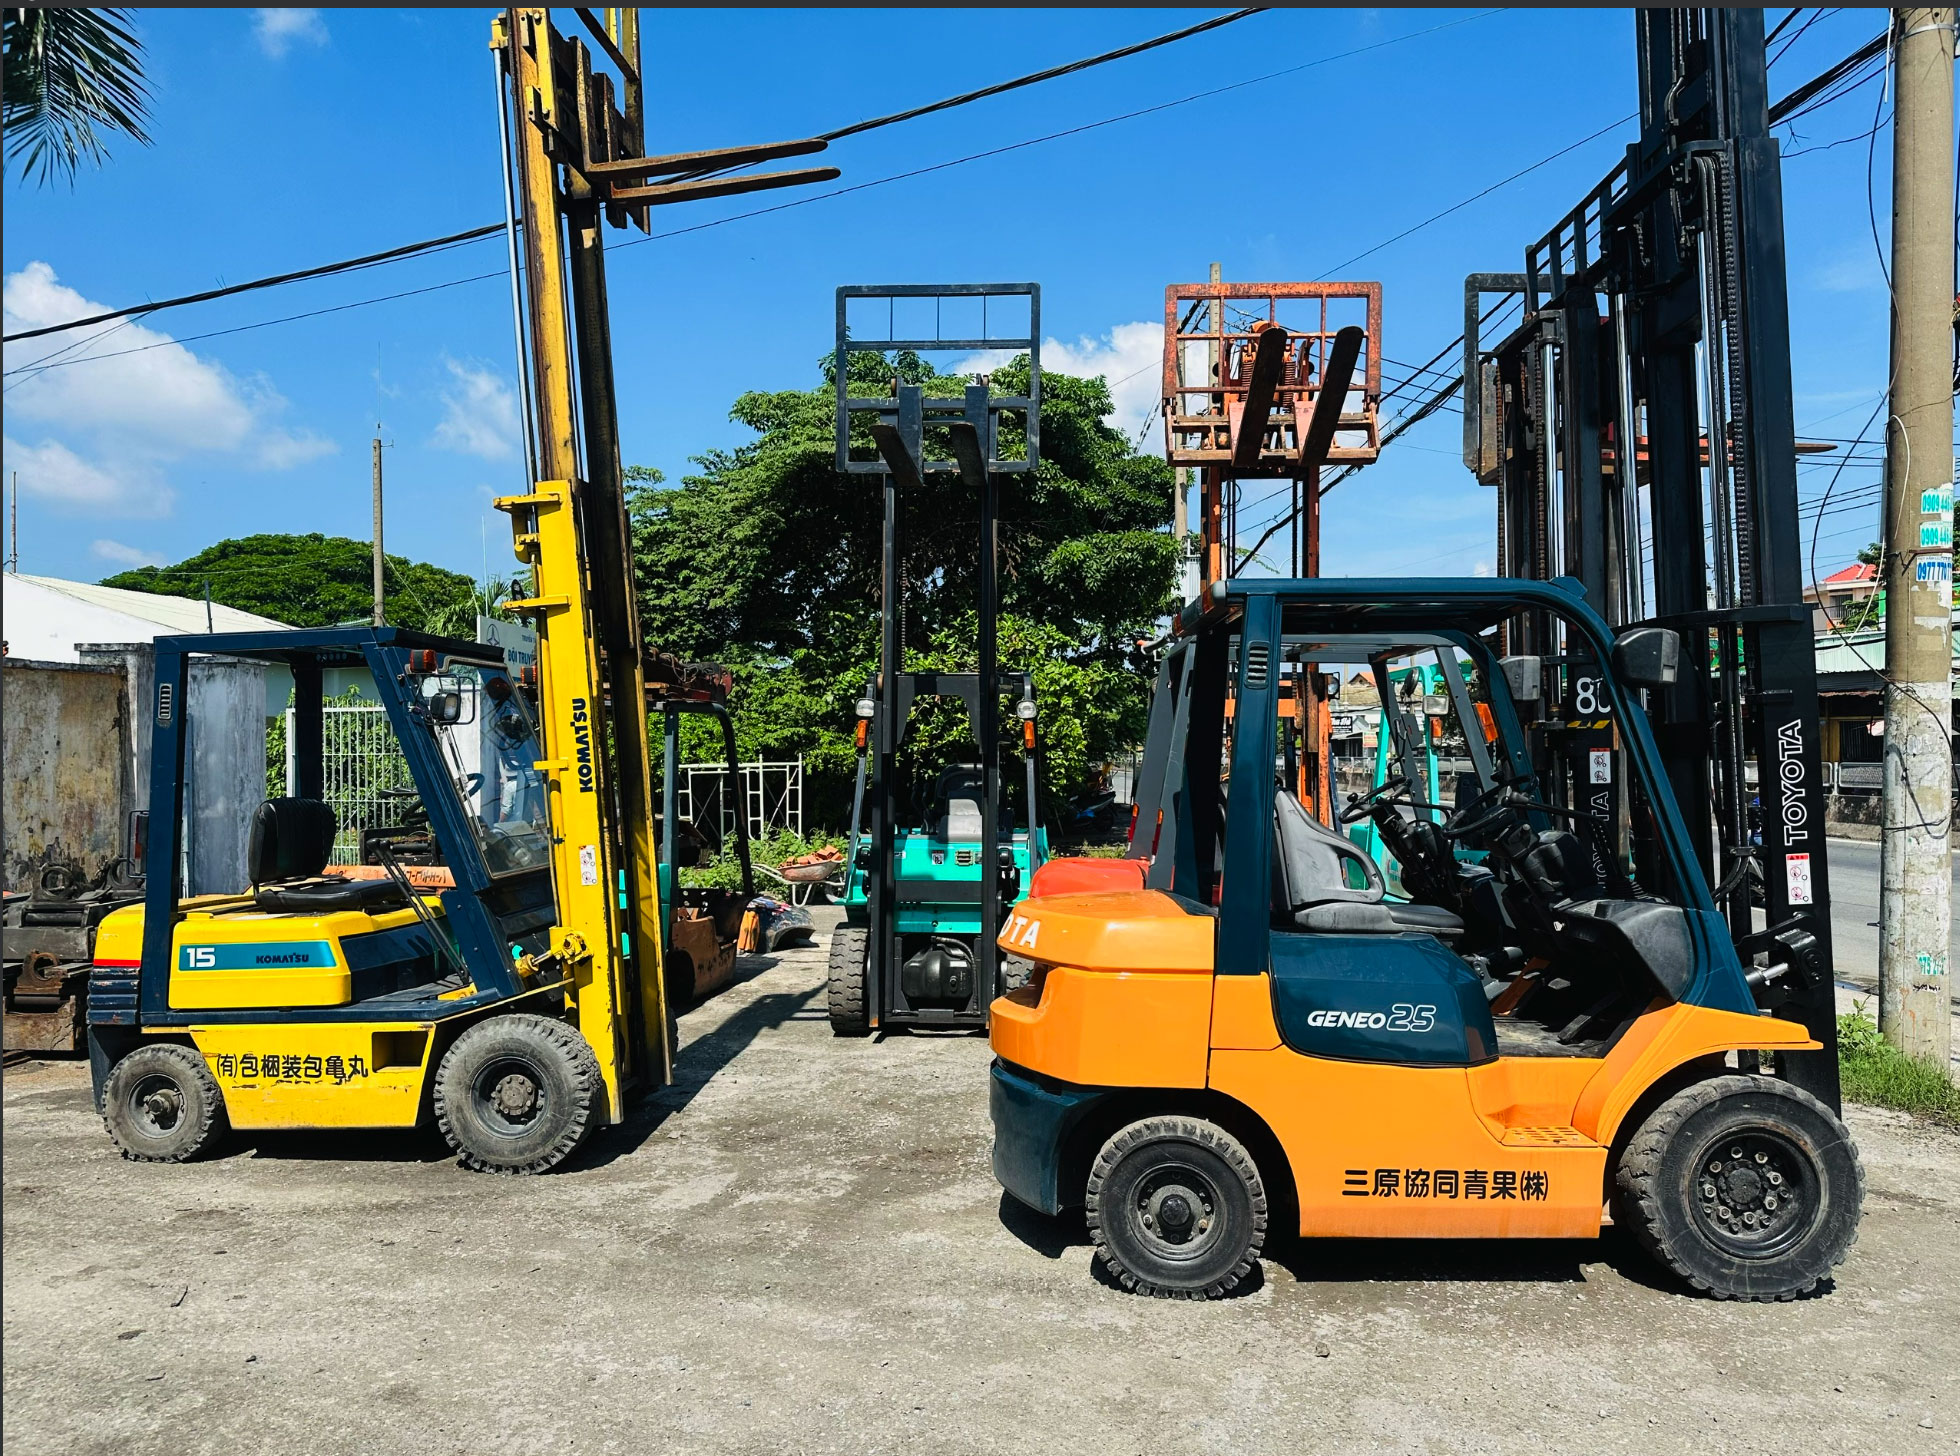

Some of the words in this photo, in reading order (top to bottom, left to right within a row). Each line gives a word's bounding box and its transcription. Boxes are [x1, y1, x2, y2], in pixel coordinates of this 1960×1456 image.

[1917, 562, 1936, 580] 0977
[570, 697, 593, 793] KOMATSU
[1778, 718, 1808, 846] TOYOTA
[186, 947, 216, 968] 15
[255, 952, 310, 964] KOMATSU
[1307, 1010, 1386, 1029] GENEO
[1386, 1003, 1437, 1032] 25
